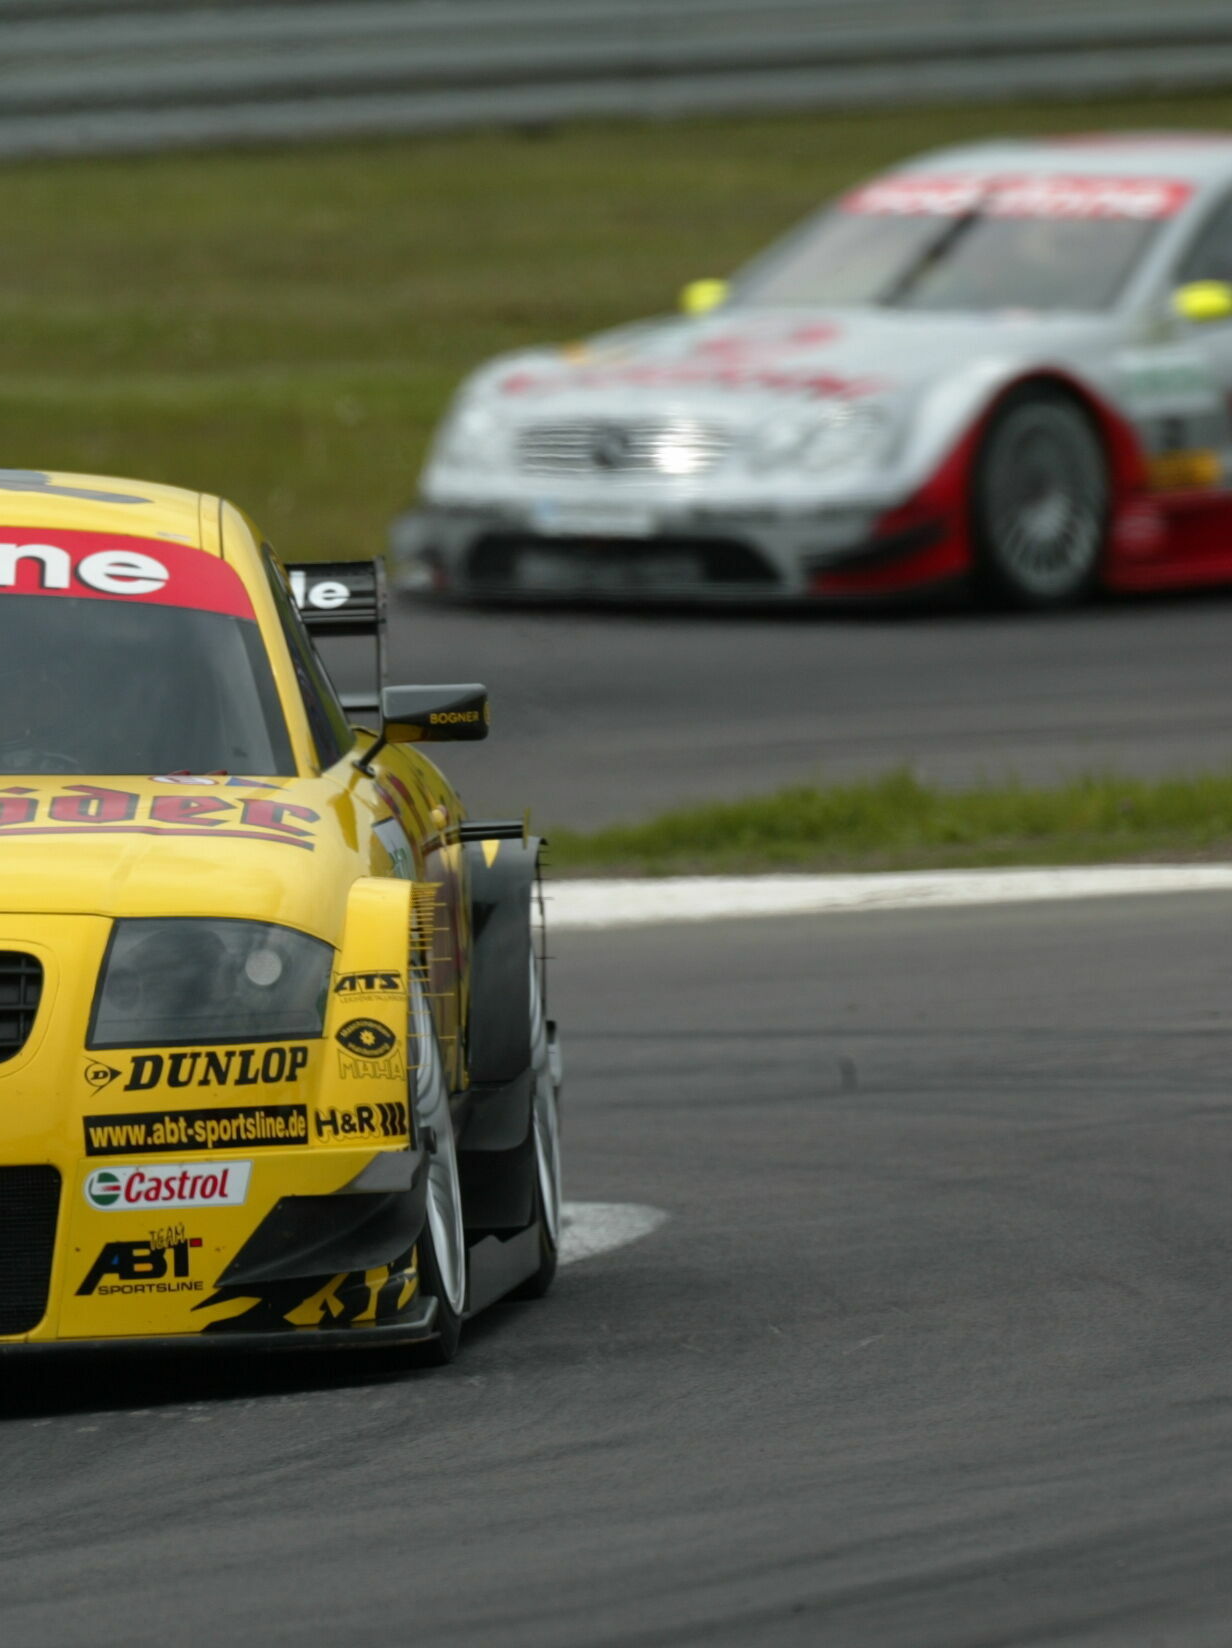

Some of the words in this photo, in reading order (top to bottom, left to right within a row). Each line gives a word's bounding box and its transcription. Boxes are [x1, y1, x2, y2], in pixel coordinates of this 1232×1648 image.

[429, 711, 480, 725] BOGNER
[333, 972, 401, 993] ATS
[123, 1046, 309, 1092] DUNLOP
[89, 1109, 307, 1149] www.abt-sportsline.de
[314, 1104, 377, 1138] H&R
[123, 1168, 230, 1203] Castrol
[74, 1237, 203, 1296] ABT
[97, 1280, 204, 1296] SPORTSLINE
